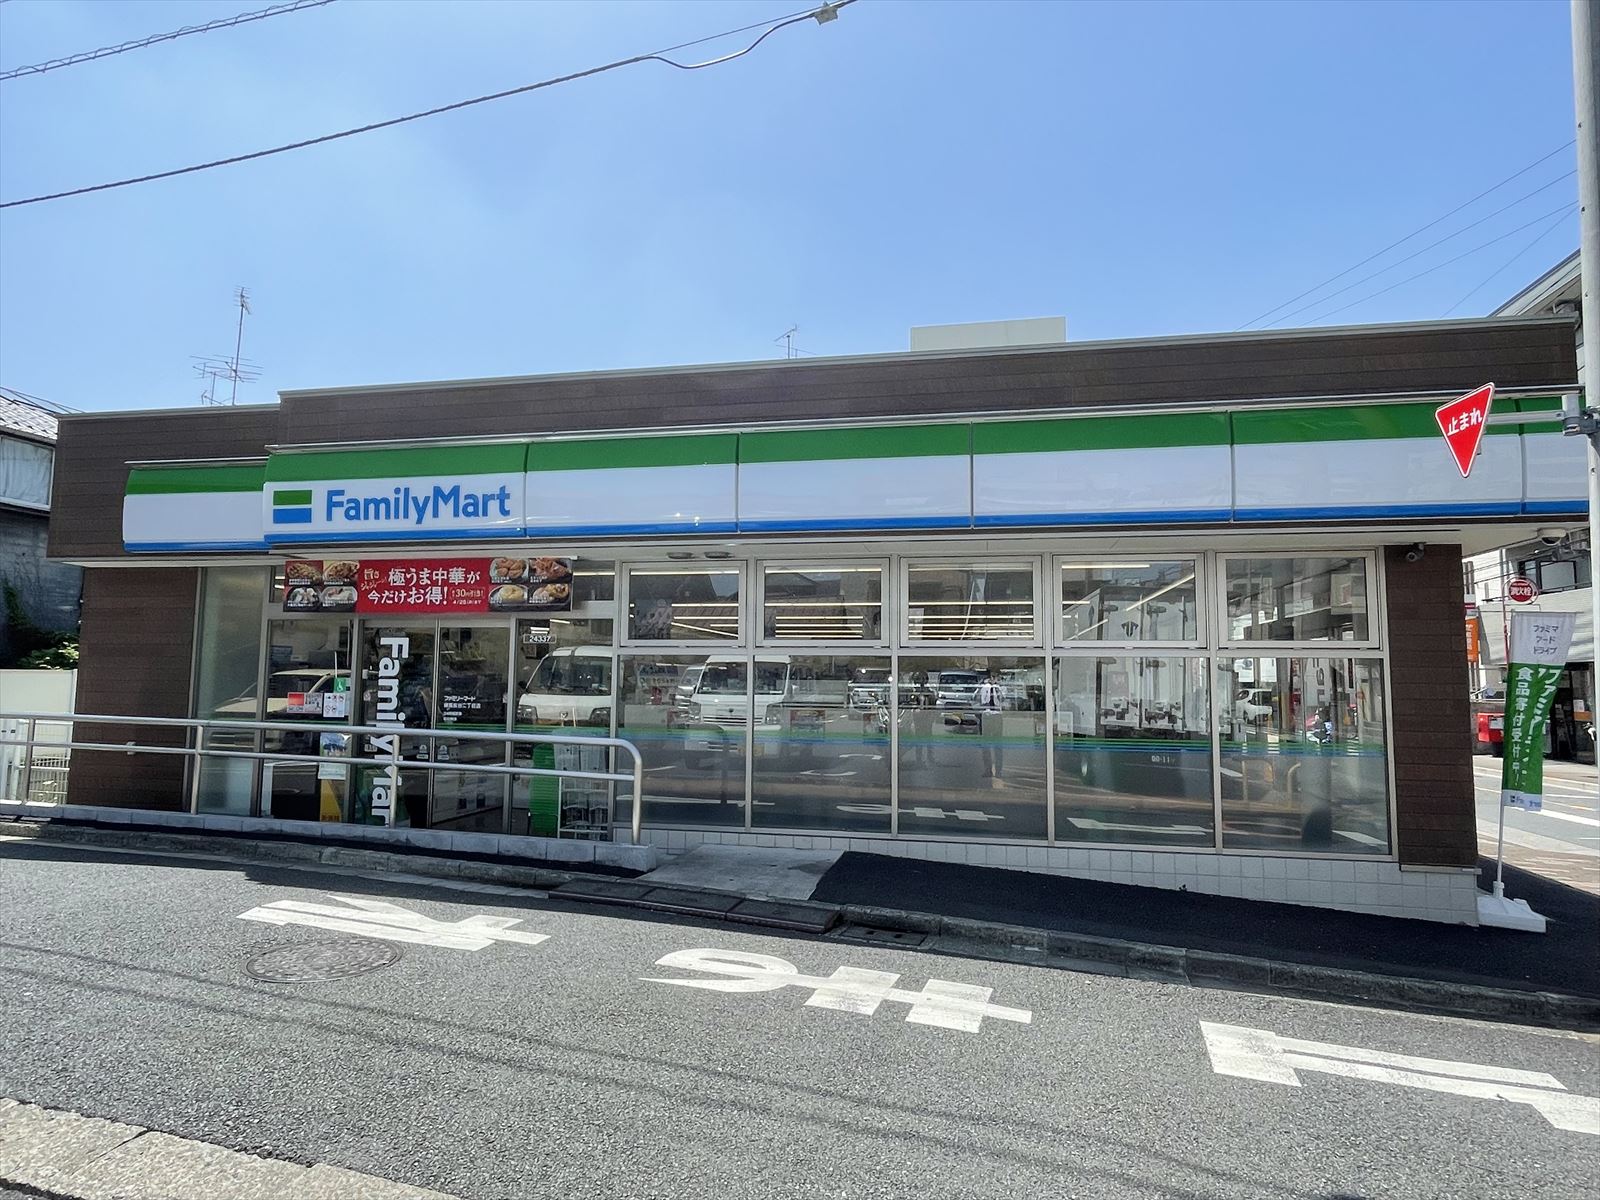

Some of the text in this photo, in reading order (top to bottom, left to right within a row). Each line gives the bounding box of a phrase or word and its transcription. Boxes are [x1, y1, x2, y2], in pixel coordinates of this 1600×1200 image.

[1447, 407, 1483, 436] 止まれ
[326, 485, 510, 525] FamilyMart
[388, 566, 481, 587] 極うま中華が
[367, 586, 448, 606] 今だけお得!
[1510, 586, 1532, 596] 消火栓
[1532, 624, 1560, 633] ファミマ
[528, 635, 552, 643] 24337
[1535, 635, 1556, 644] フード
